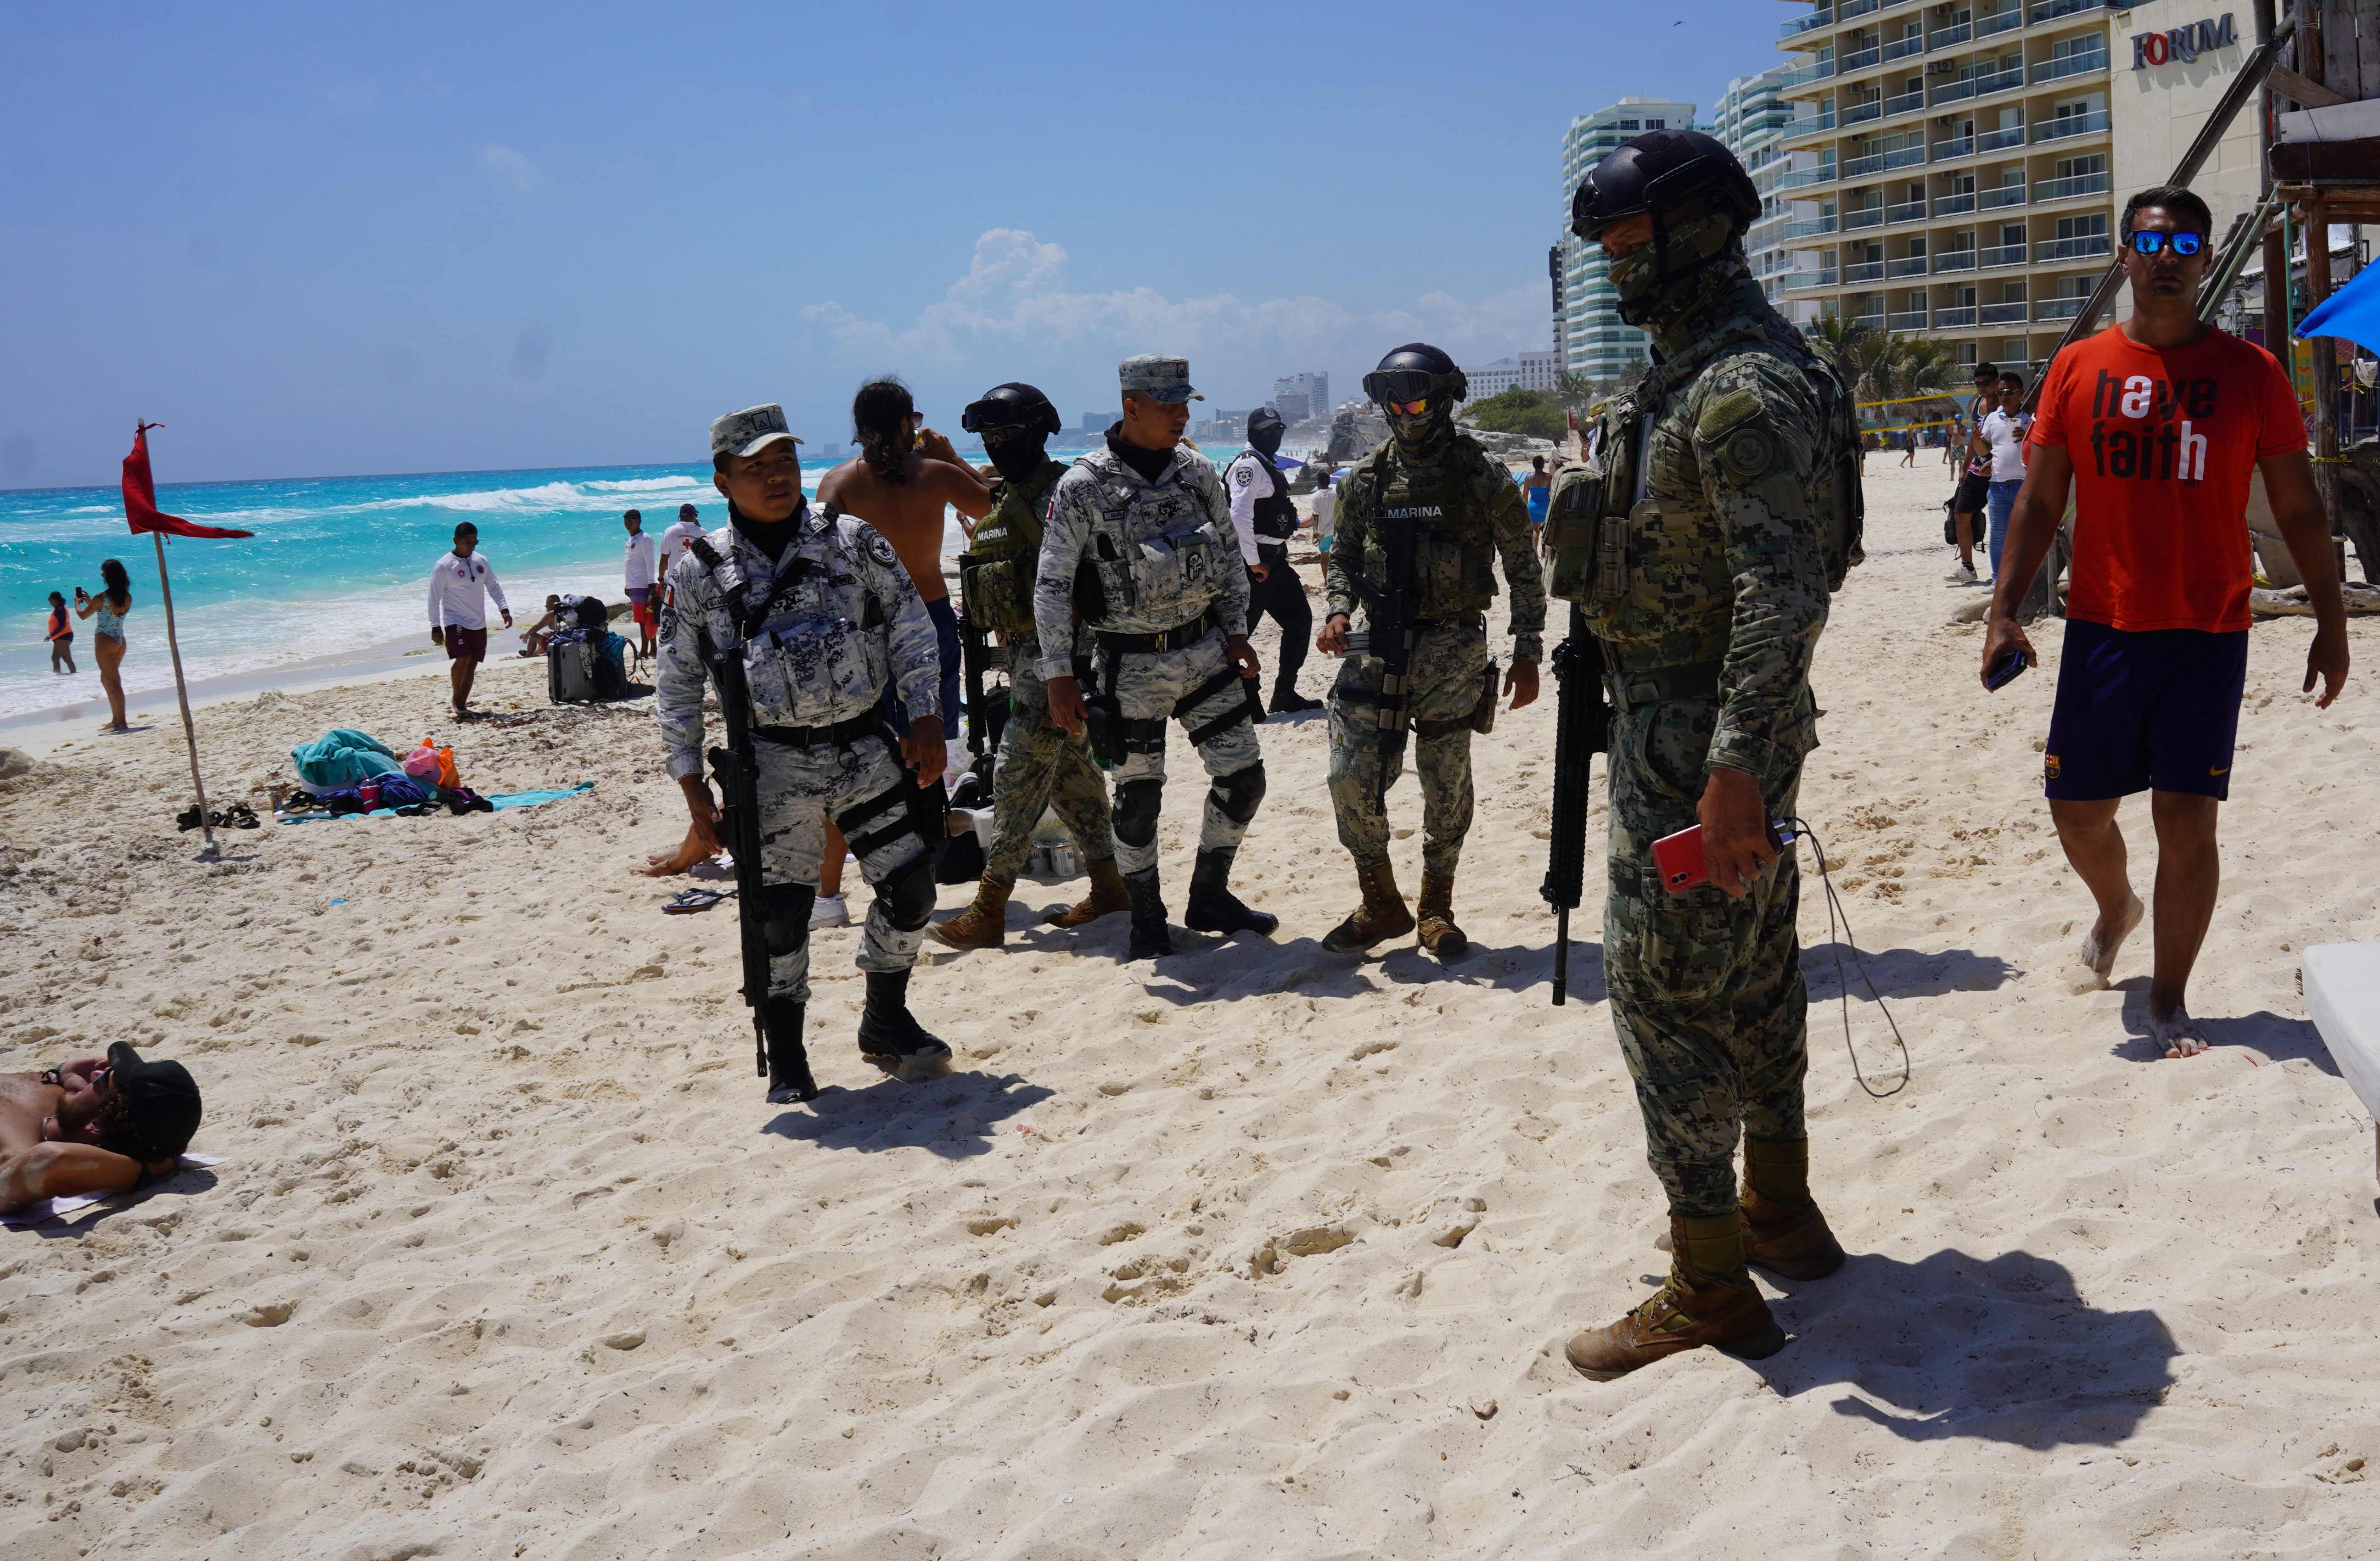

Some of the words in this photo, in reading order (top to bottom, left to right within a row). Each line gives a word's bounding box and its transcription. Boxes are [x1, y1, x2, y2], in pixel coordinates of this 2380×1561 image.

[2130, 12, 2235, 71] FORUM
[2092, 369, 2217, 421] have
[2090, 420, 2207, 481] faith
[977, 527, 1007, 542] MARINA
[1387, 506, 1443, 518] MARINA
